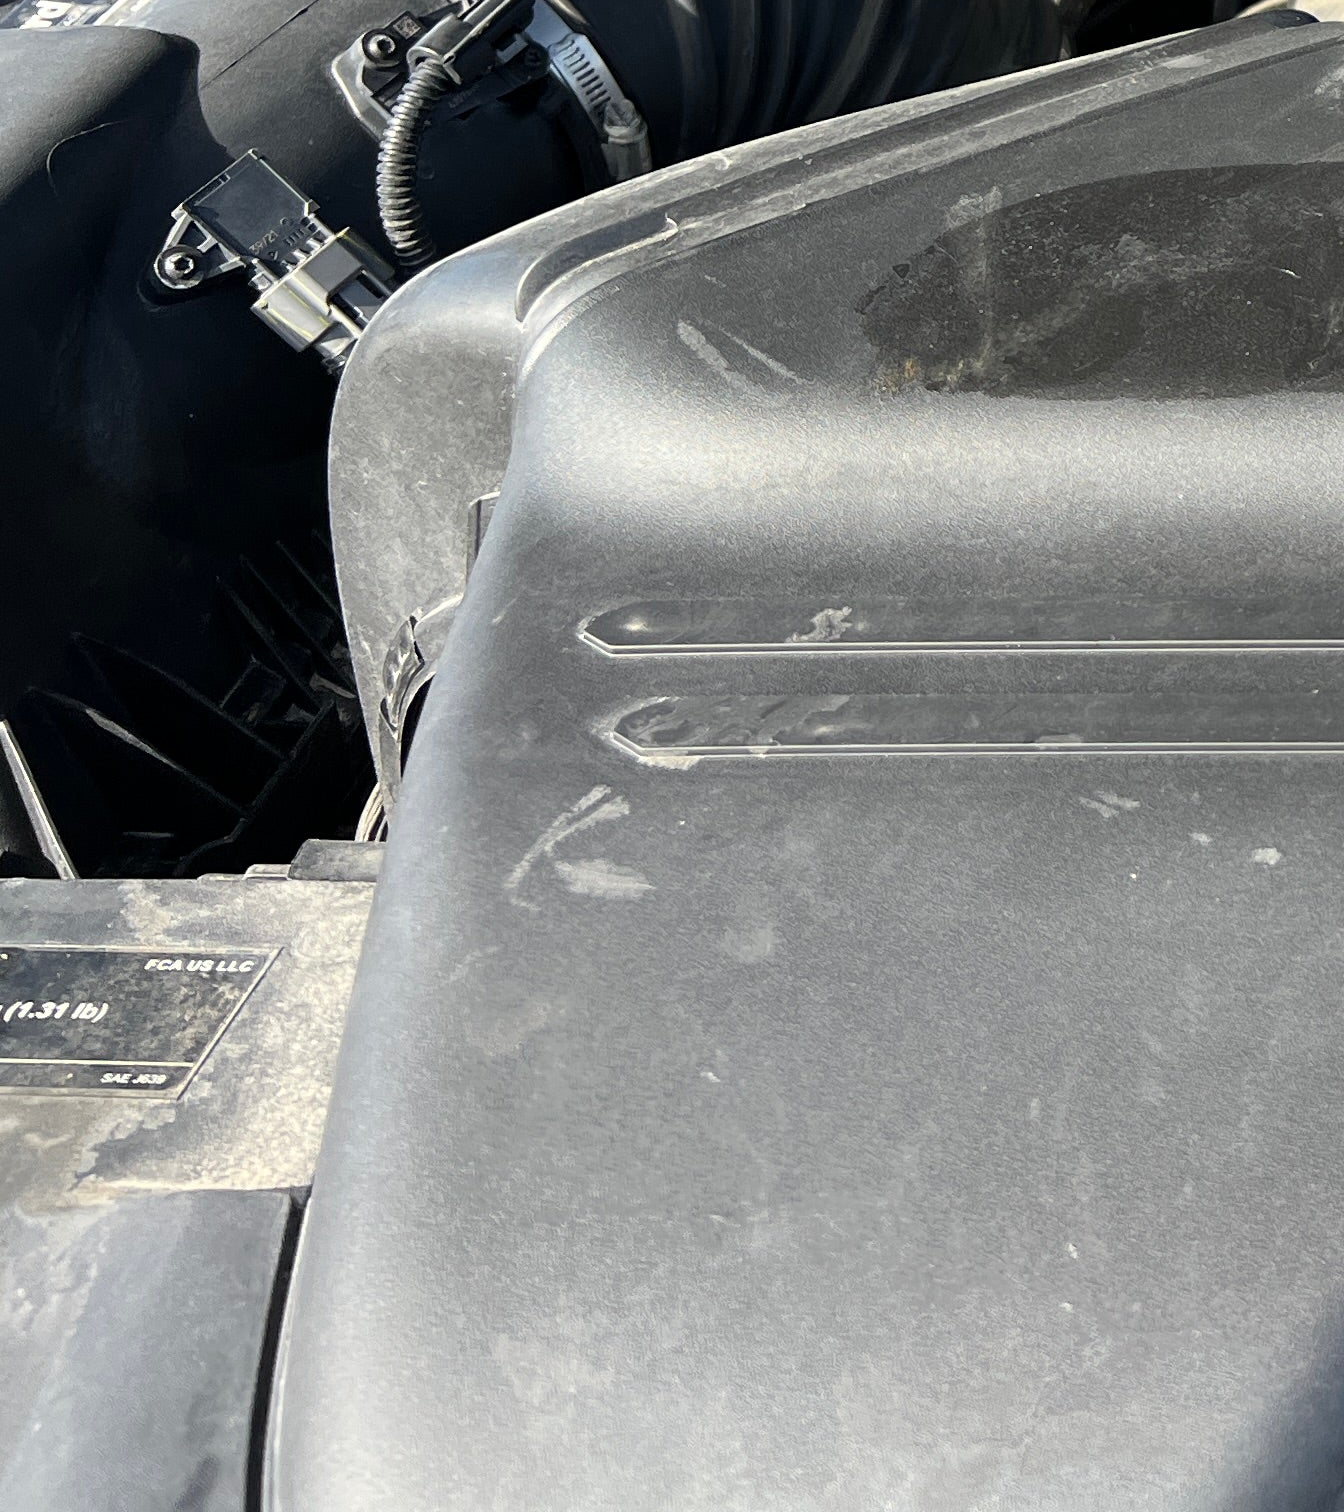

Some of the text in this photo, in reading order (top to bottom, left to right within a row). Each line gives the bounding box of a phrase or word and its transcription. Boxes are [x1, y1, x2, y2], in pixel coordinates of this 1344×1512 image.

[143, 958, 255, 973] FCA US LLC
[3, 1000, 70, 1023] (1.31
[71, 1001, 109, 1024] lb)
[100, 1072, 133, 1085] SAE
